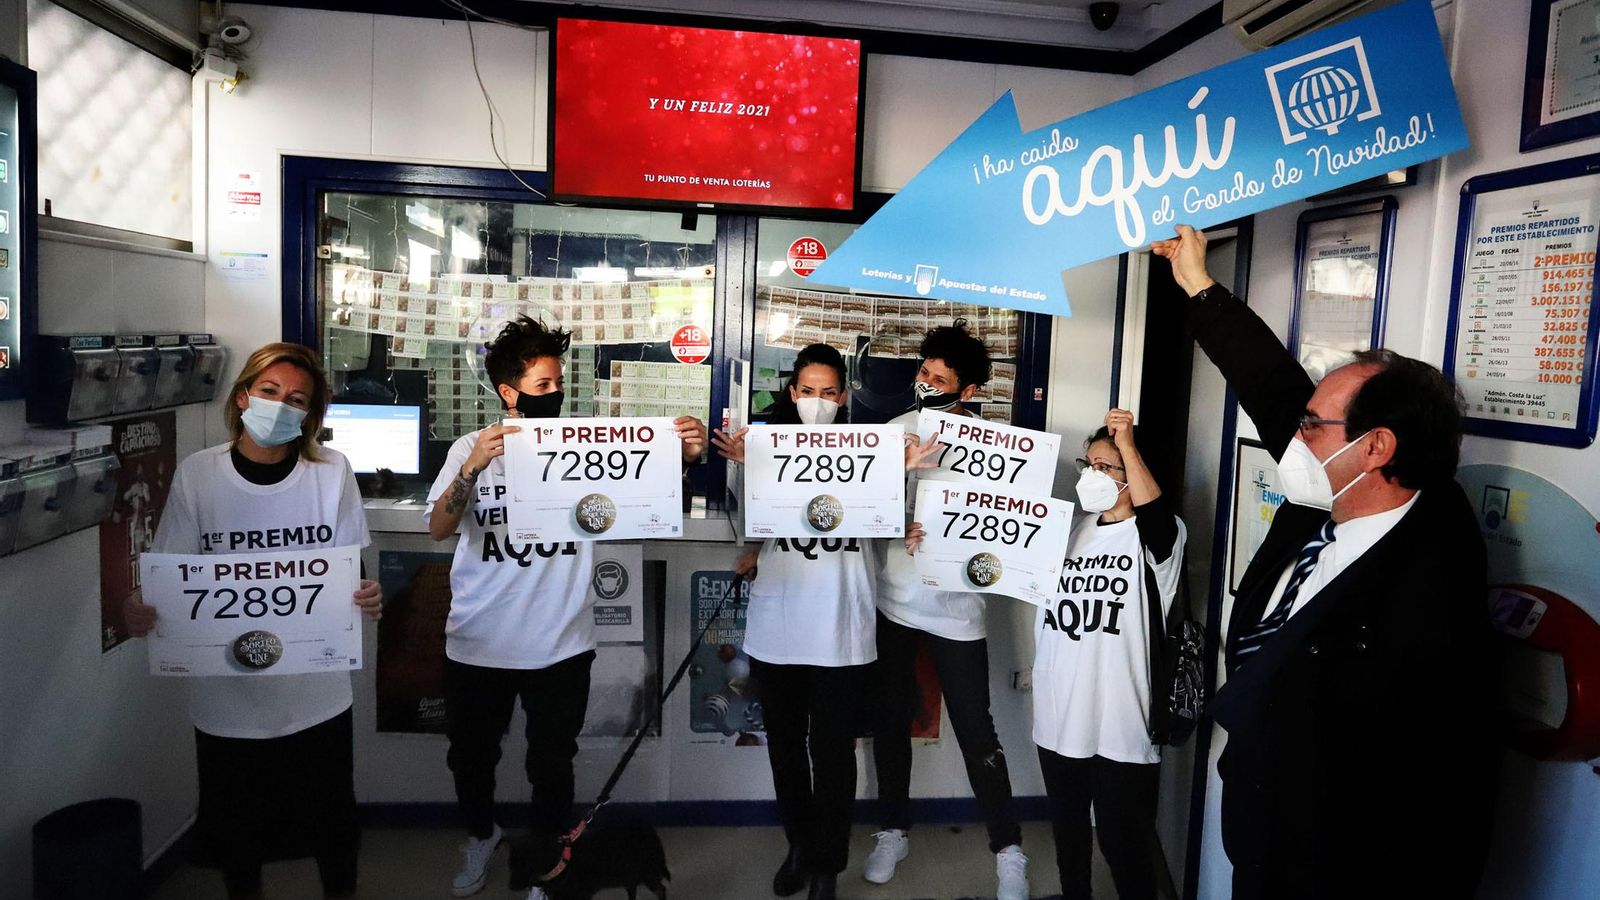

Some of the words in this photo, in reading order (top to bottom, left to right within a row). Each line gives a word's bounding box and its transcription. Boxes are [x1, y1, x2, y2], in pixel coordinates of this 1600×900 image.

[648, 97, 660, 110] Y
[663, 98, 686, 112] UN
[690, 100, 733, 115] FELIZ
[737, 102, 770, 117] 2021
[1020, 128, 1079, 167] caido
[1022, 86, 1236, 248] aquí
[644, 173, 655, 182] TU
[657, 175, 687, 184] PUNTO
[689, 176, 700, 185] DE
[703, 177, 730, 187] VENTA
[732, 177, 771, 188] LOTERÍAS
[1152, 195, 1175, 225] el
[1183, 170, 1265, 214] Gordo
[1272, 157, 1303, 188] de
[1491, 223, 1526, 234] PREMIOS
[1528, 216, 1580, 230] REPARTIDOS
[1477, 234, 1493, 244] POR
[1495, 233, 1515, 243] ESTE
[1517, 225, 1594, 241] ESTABLECIMIENTO
[796, 241, 818, 255] +18
[1545, 242, 1572, 250] PREMIOS
[861, 266, 903, 282] Loterías
[905, 274, 912, 284] y
[938, 277, 987, 295] Apuestas
[990, 283, 1007, 296] del
[1009, 286, 1047, 301] Estado
[1543, 269, 1584, 280] 914.465
[1542, 282, 1583, 293] 156.197
[1531, 295, 1581, 306] 3.007.151
[1545, 309, 1580, 319] 75.307
[679, 328, 702, 342] +18
[1543, 321, 1578, 332] 32.825
[1542, 334, 1577, 345] 47.408
[1534, 347, 1575, 358] 387.655
[1539, 360, 1573, 371] 58.092
[1538, 373, 1572, 384] 10.000
[1484, 396, 1526, 406] Establecimiento
[1508, 391, 1524, 399] Costa
[534, 427, 553, 444] 1er
[562, 426, 655, 444] PREMIO
[771, 432, 789, 448] 1er
[796, 432, 880, 448] PREMIO
[939, 419, 954, 435] 1er
[958, 424, 1034, 453] PREMIO
[537, 450, 651, 482] 72897
[773, 455, 876, 483] 72897
[938, 441, 1027, 484] 72897
[942, 489, 960, 505] 1er
[966, 491, 1049, 519] PREMIO
[201, 531, 224, 551] 1er
[229, 524, 333, 550] PREMIO
[942, 511, 1042, 549] 72897
[178, 562, 204, 582] 1er
[214, 558, 329, 581] PREMIO
[1057, 574, 1129, 596] NDIDO
[183, 583, 324, 620] 72897
